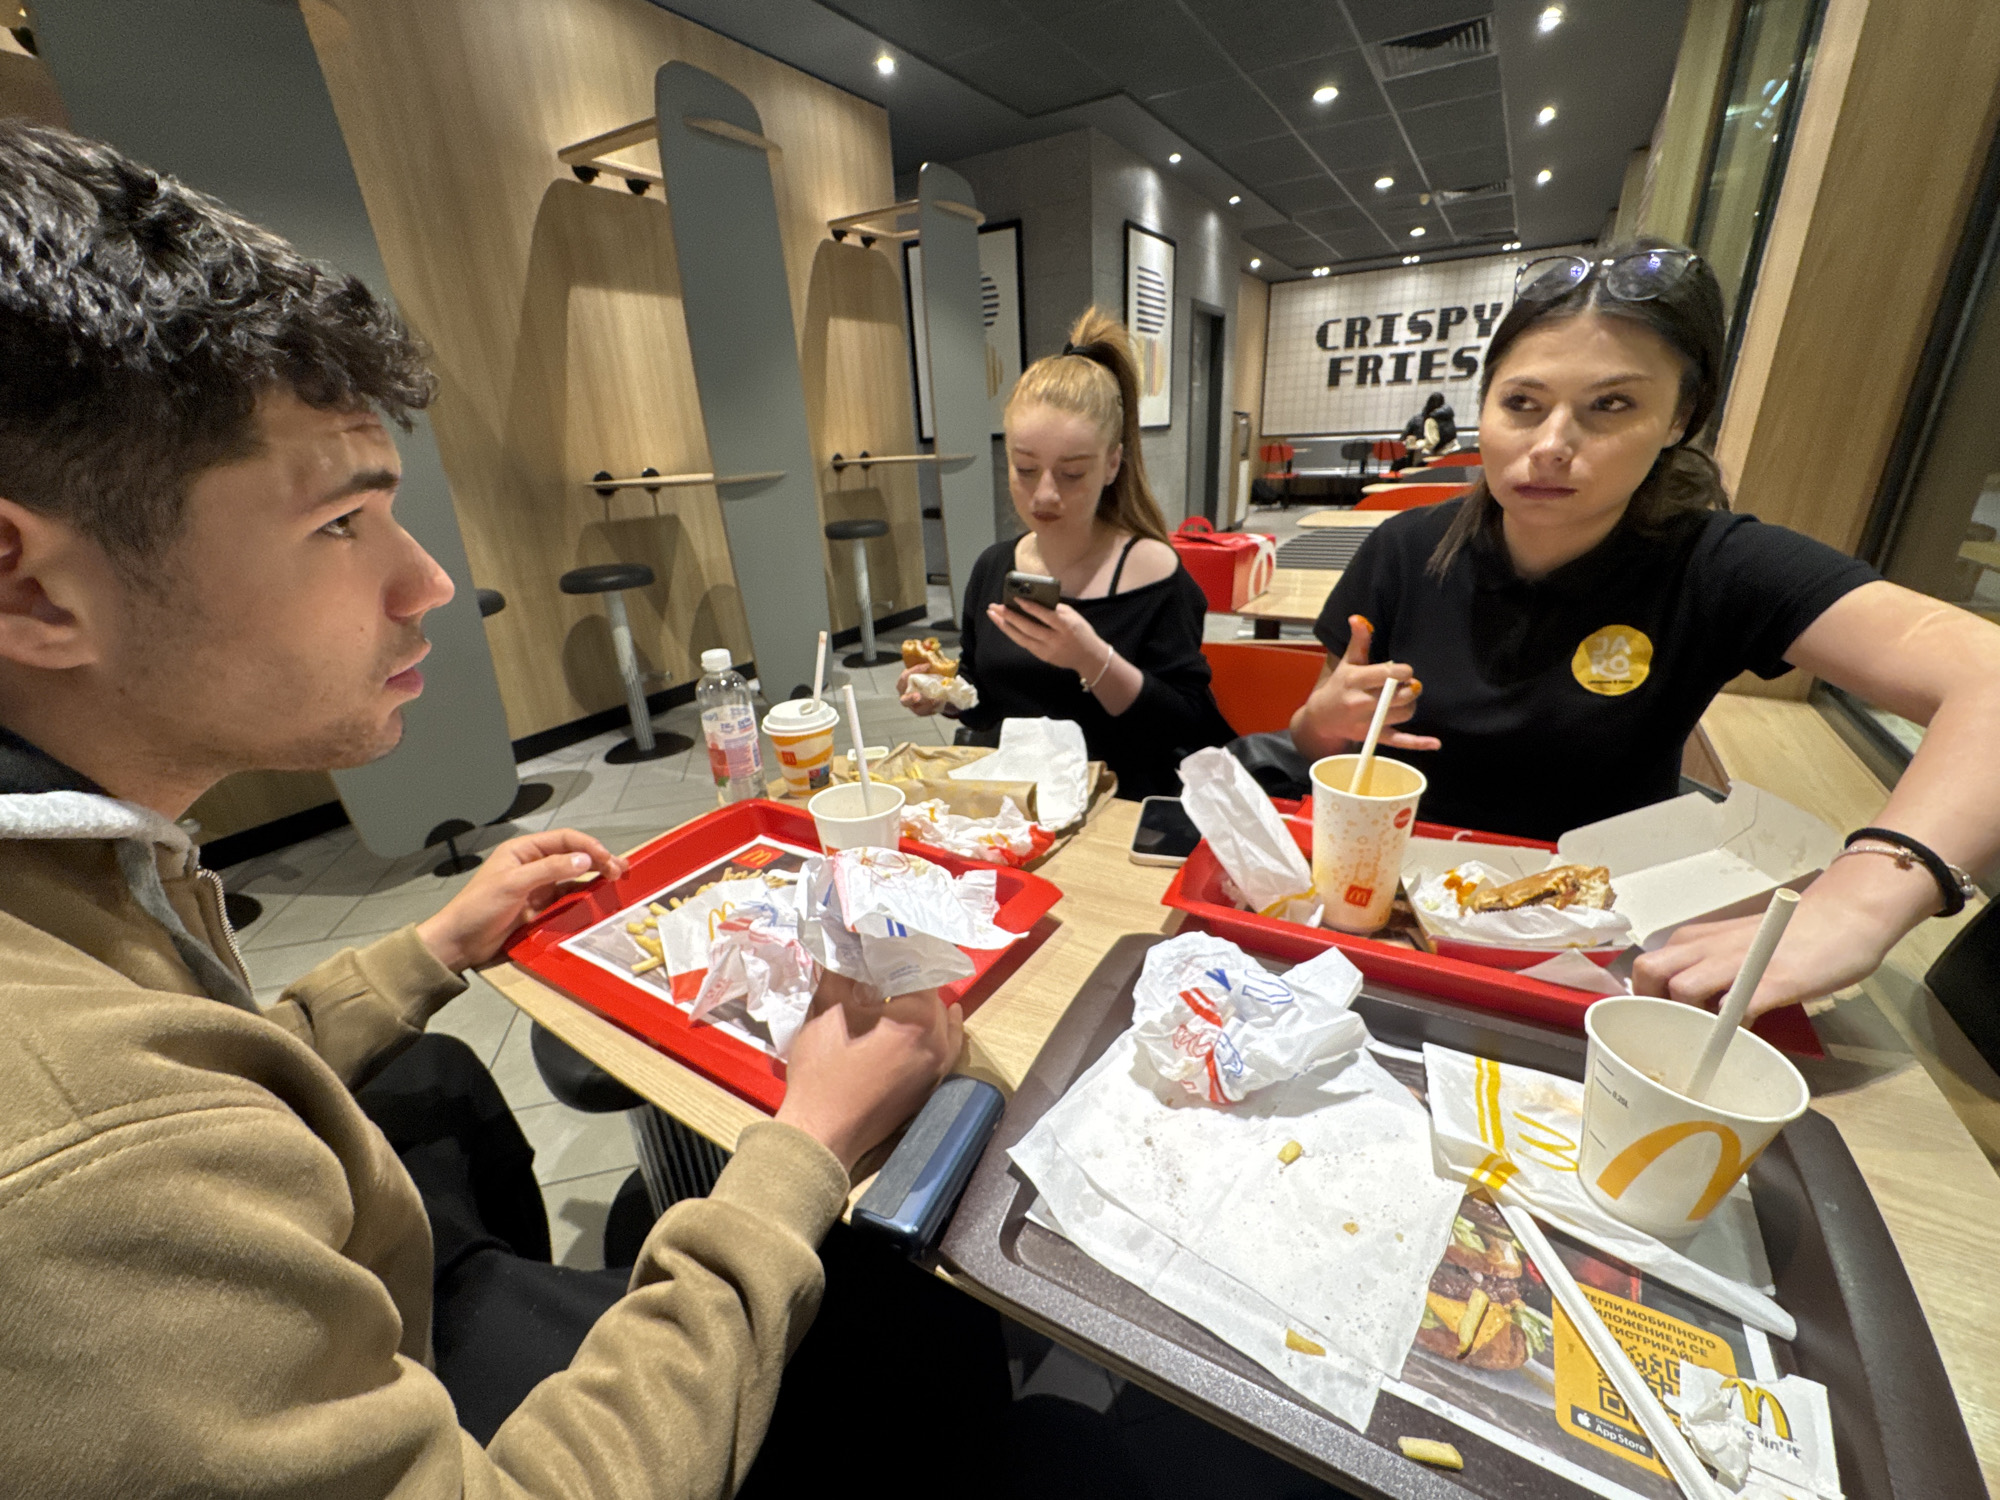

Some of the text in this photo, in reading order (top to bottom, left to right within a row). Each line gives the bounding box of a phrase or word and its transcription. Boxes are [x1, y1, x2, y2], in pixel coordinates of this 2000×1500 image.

[1316, 302, 1504, 351] CRISPY
[1327, 345, 1482, 388] FRIES
[1583, 1291, 1717, 1350] ТЕГЛИ МОБИЛНОТО
[1594, 1306, 1709, 1358] ИЛОЖЕНИЕ И СЕ
[1607, 1323, 1695, 1364] ГИСТРИРАЙ!
[1595, 1423, 1647, 1454] App Store
[1786, 1443, 1802, 1460] it
